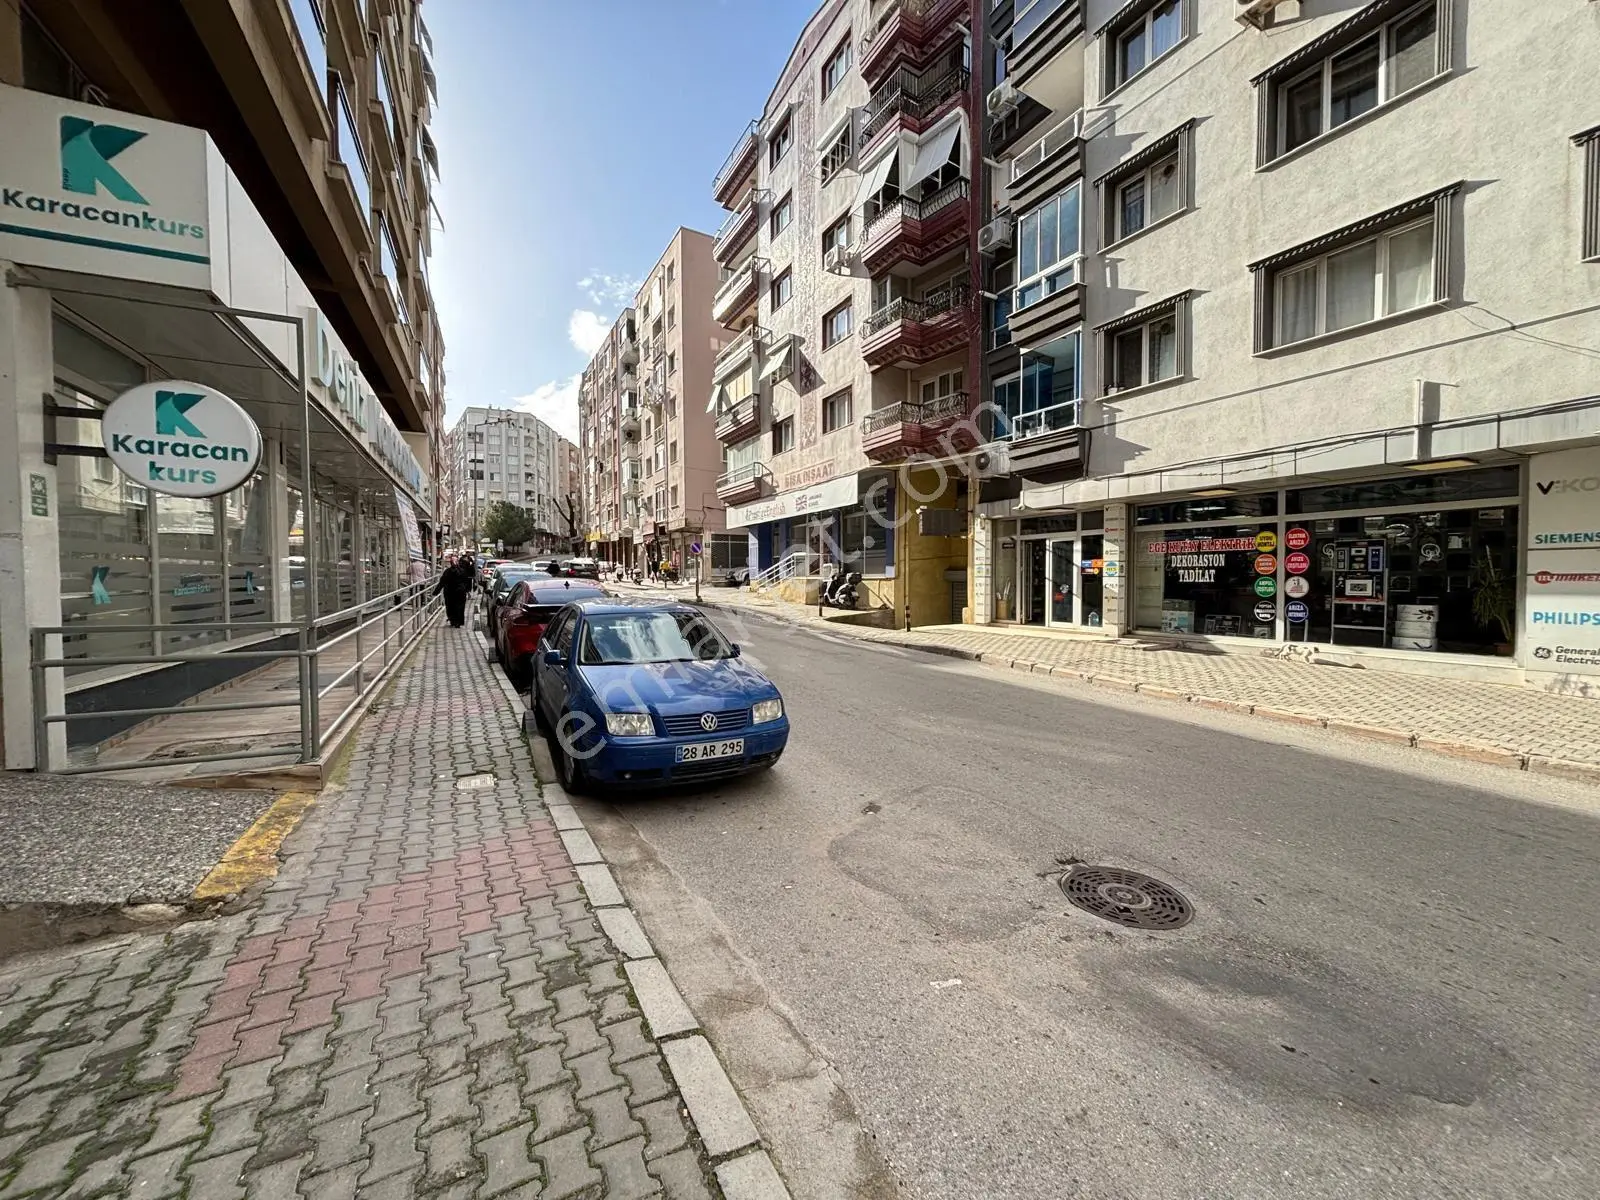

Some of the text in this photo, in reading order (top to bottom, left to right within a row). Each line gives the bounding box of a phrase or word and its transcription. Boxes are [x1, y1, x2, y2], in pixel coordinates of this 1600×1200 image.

[112, 434, 249, 462] Karacan
[149, 461, 217, 484] kurs
[1149, 542, 1167, 553] EGE
[1171, 554, 1226, 567] DEKORASYON
[1178, 567, 1216, 582] TADİLAT
[1533, 611, 1600, 626] PHILIPS
[1555, 646, 1600, 656] General
[1555, 655, 1600, 665] Electric
[683, 747, 697, 760] 28
[701, 745, 716, 757] AR
[721, 741, 742, 755] 295
